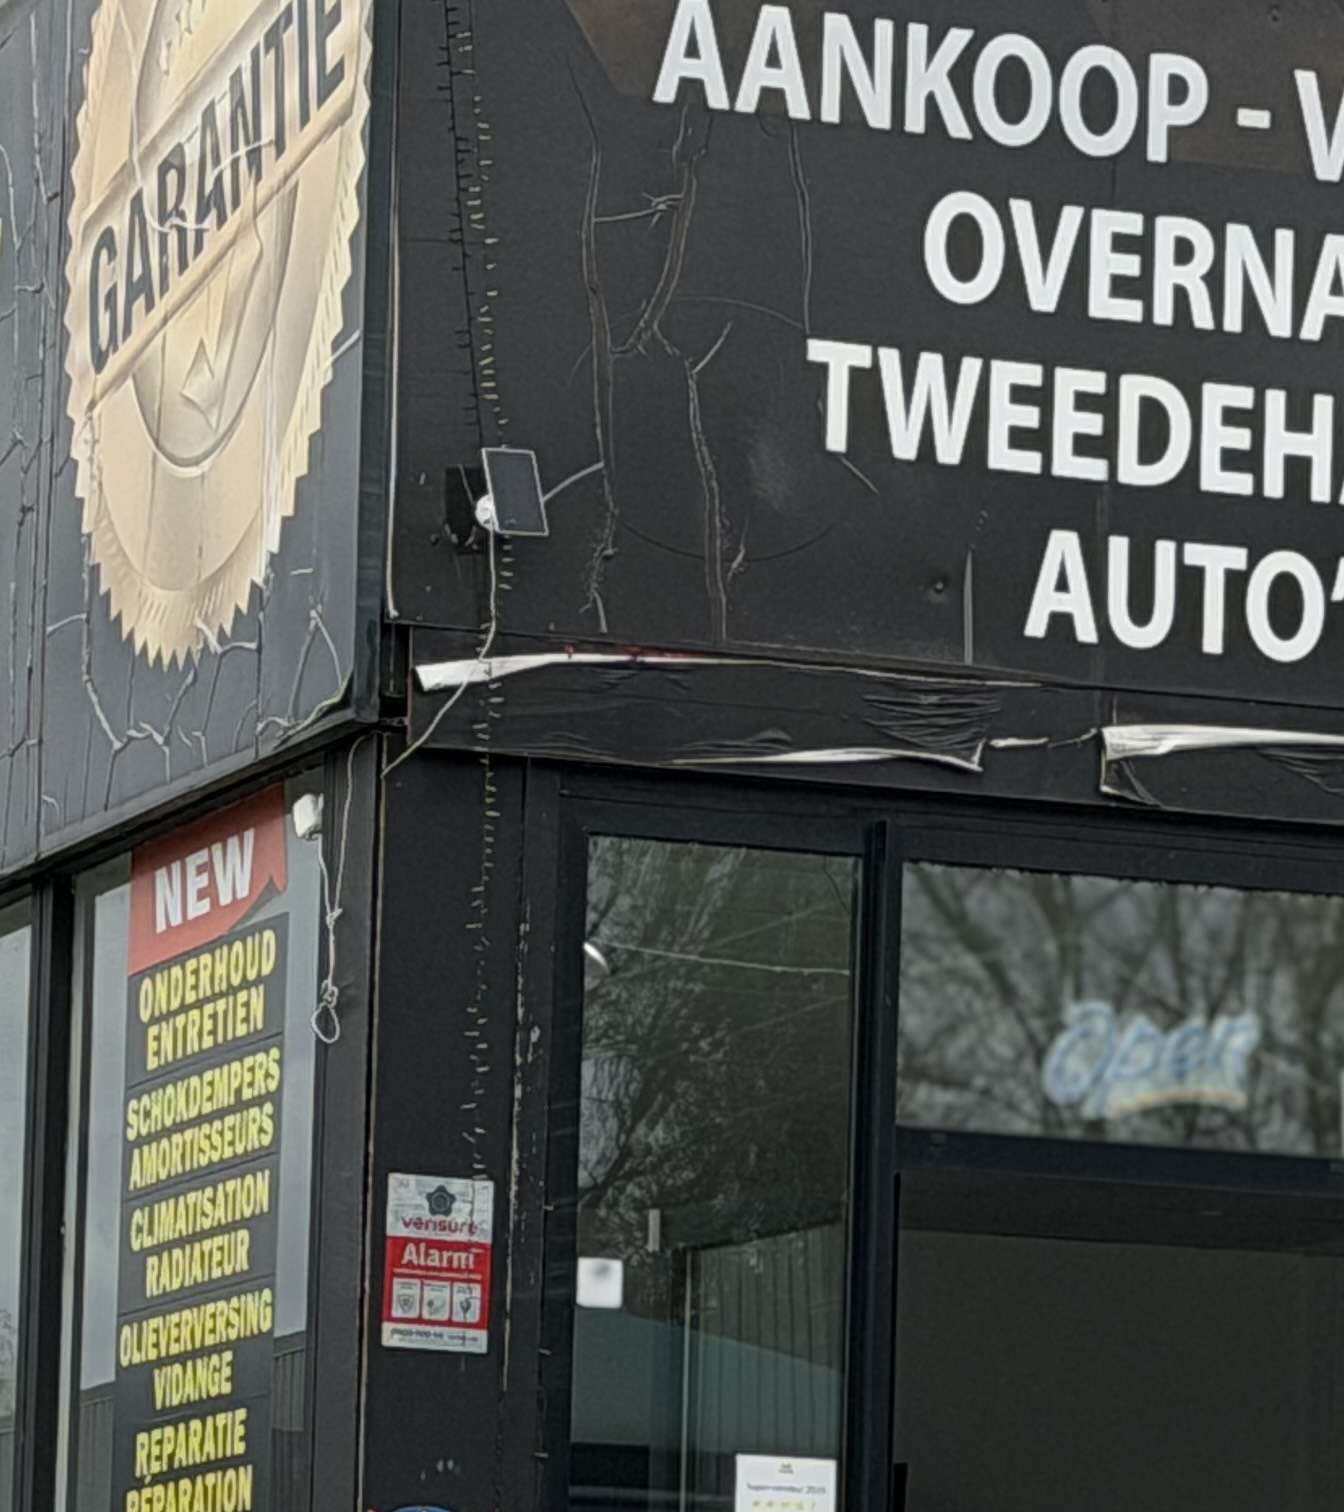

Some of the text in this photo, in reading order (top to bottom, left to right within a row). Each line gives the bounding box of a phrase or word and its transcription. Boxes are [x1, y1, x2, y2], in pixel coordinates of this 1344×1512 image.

[652, 0, 1209, 164] AANKOOP
[89, 0, 346, 375] GARANTIE
[154, 827, 255, 934] NEW
[139, 928, 277, 1024] ONDERHOUD
[146, 983, 265, 1072] ENTRETIEN
[126, 1047, 281, 1142] SCHOKDEMPERS
[128, 1100, 275, 1191] AMORTISSEURS
[129, 1168, 271, 1252] CLIMATISATION
[401, 1215, 478, 1235] verisure
[145, 1228, 251, 1299] RADIATEUR
[400, 1242, 476, 1271] Alarm
[119, 1287, 273, 1369] OLIEVERVERSING
[153, 1349, 234, 1411] VIDANGE
[134, 1407, 248, 1478] REPARATIE
